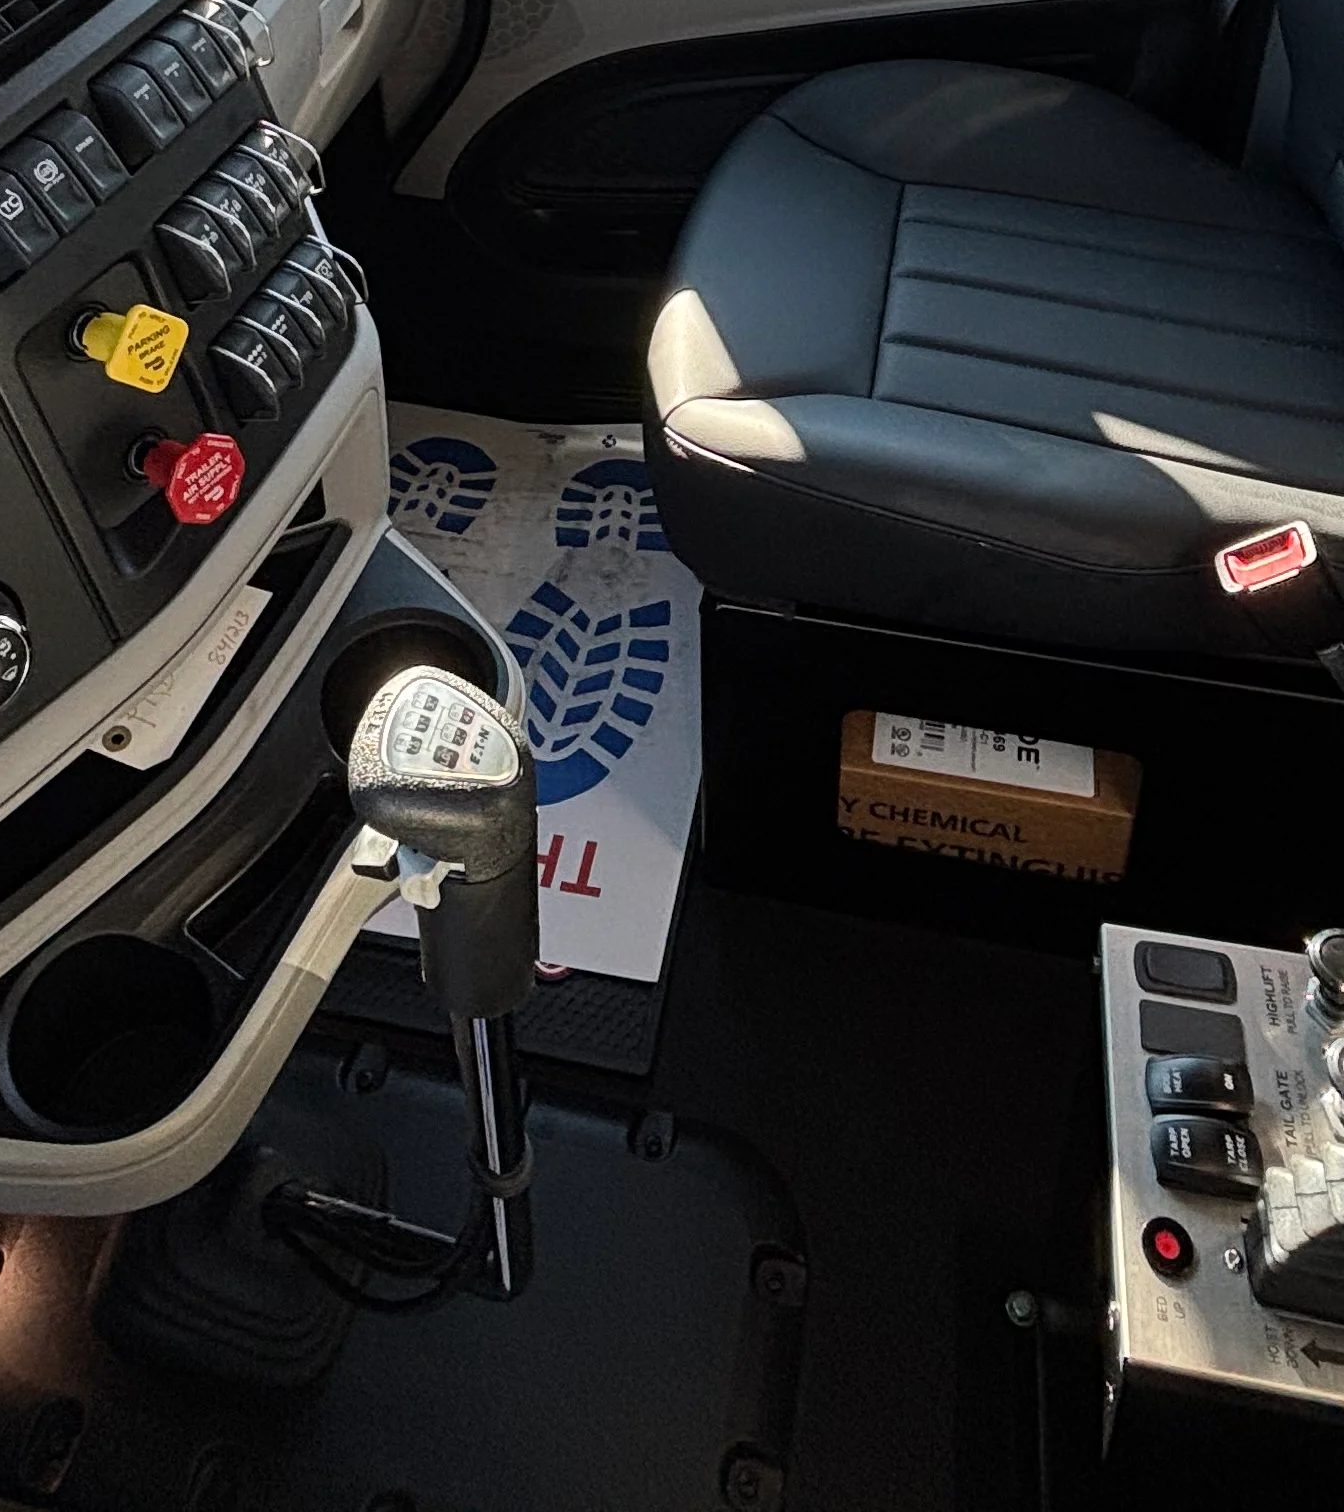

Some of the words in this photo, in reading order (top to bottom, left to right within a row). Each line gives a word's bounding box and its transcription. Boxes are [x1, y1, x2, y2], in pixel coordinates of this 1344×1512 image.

[127, 325, 171, 356] PARKING
[139, 340, 166, 360] BRAKE
[183, 485, 199, 502] AIR
[198, 455, 232, 488] SUPPLY
[185, 451, 223, 486] TRAILER
[208, 610, 250, 665] 841213
[868, 801, 1028, 844] CHEMICAL
[1260, 964, 1281, 1027] HIGHLIFT
[1283, 996, 1293, 1009] TO
[1223, 1073, 1235, 1090] ON
[1276, 1069, 1294, 1111] GATE
[1168, 1127, 1179, 1157] TARP
[1180, 1127, 1192, 1158] OPEN
[1283, 1114, 1298, 1148] TAIL
[1224, 1134, 1236, 1164] TARP
[1235, 1135, 1248, 1172] CLOSE
[1156, 1295, 1169, 1322] BED
[1172, 1301, 1186, 1320] UP
[1265, 1324, 1281, 1365] HOIST
